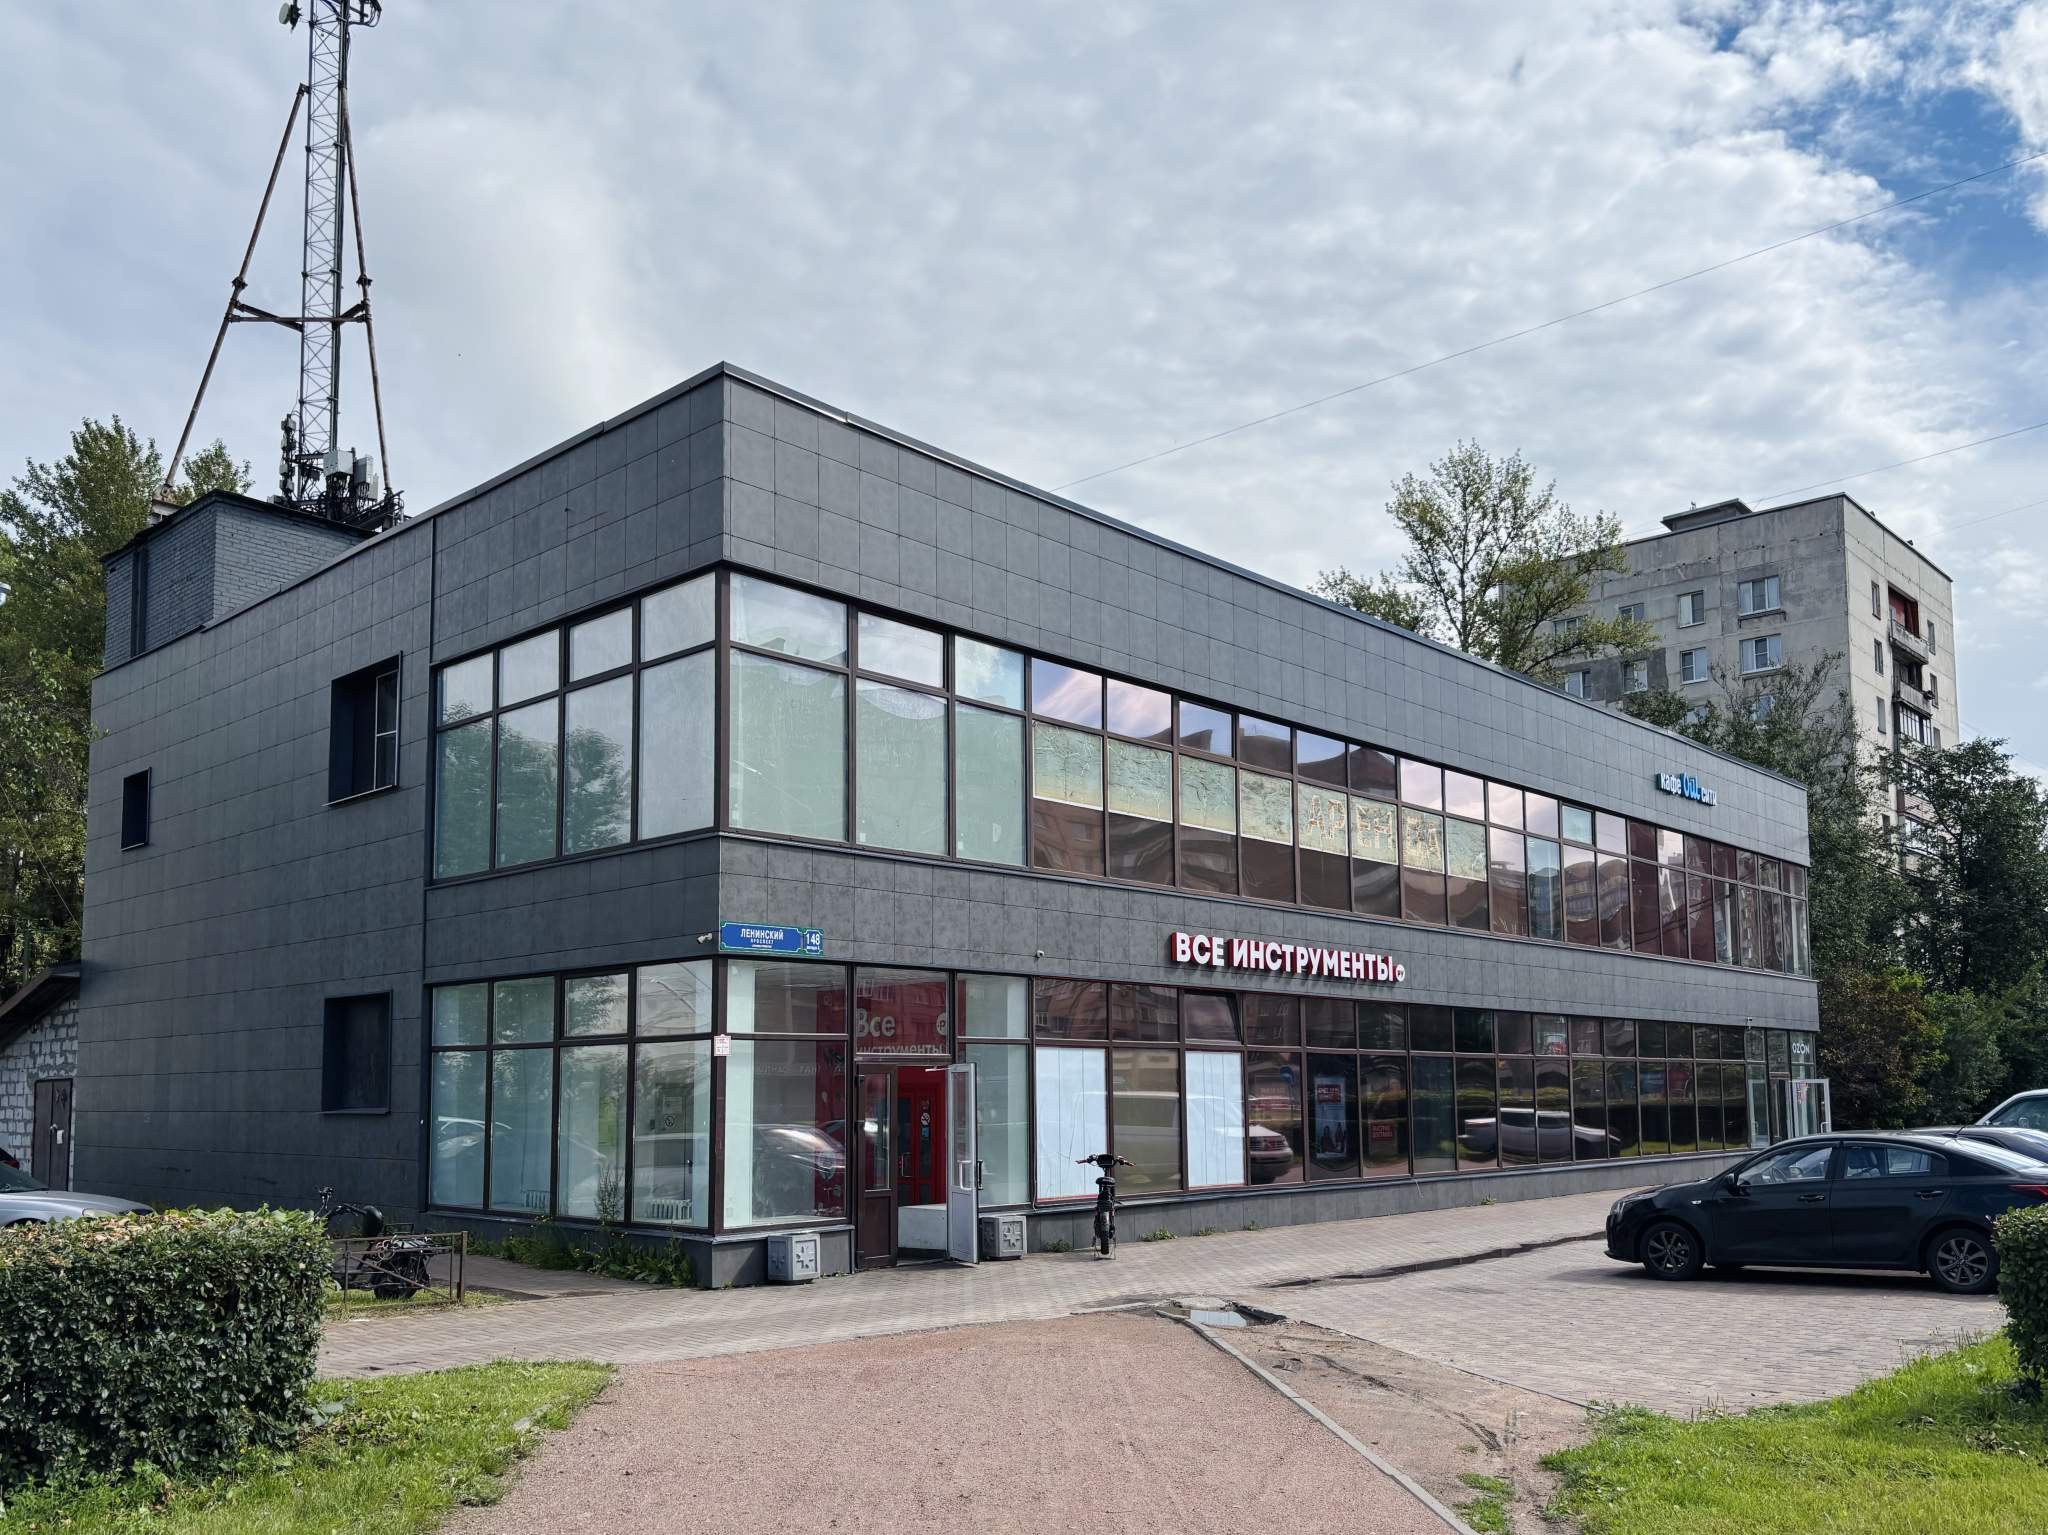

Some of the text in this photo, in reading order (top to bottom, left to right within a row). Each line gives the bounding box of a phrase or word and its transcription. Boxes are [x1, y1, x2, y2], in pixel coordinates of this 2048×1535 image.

[740, 928, 784, 941] ЛЕНИНСКИЙ
[806, 933, 821, 946] 148
[1174, 931, 1225, 967] ВСЕ
[1233, 937, 1393, 982] ИНСТРУМЕНТЫ
[856, 1008, 896, 1038] Все
[1792, 1042, 1810, 1055] OZON
